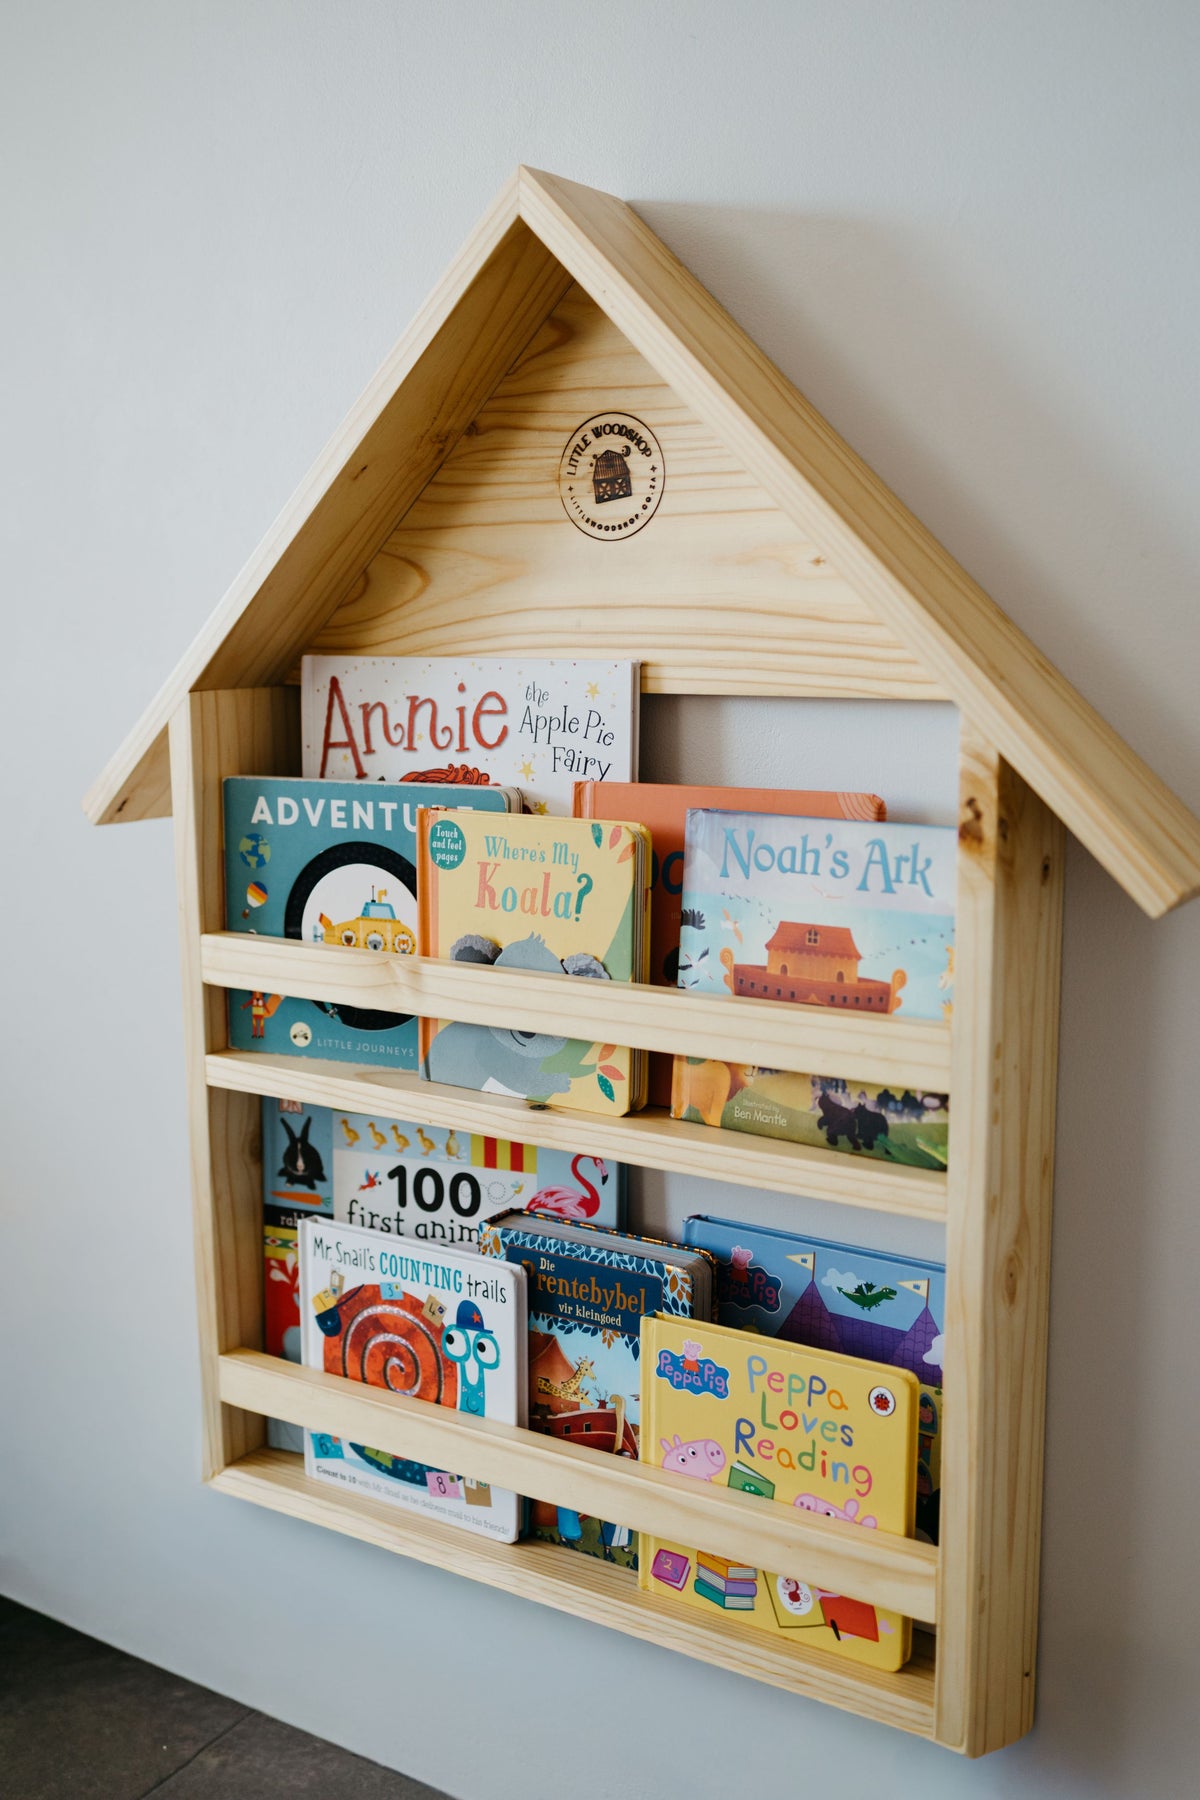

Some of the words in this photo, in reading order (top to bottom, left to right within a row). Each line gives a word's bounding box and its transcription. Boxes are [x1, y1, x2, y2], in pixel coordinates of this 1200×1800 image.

[567, 434, 592, 476] LITTLE
[591, 423, 652, 457] WOODSHOP
[525, 681, 550, 708] the
[319, 675, 509, 779] Annie
[518, 705, 580, 745] Apple
[583, 709, 615, 747] Pie
[551, 746, 612, 782] Fairy
[251, 796, 473, 833] ADVENTU
[435, 825, 459, 839] Touch
[432, 838, 446, 849] and
[447, 839, 462, 851] feel
[435, 852, 458, 865] pages
[484, 835, 547, 864] Where's
[552, 841, 580, 875] My
[719, 827, 850, 880] Noah's
[856, 838, 935, 898] Ark
[474, 861, 594, 922] Koala?
[317, 1038, 355, 1050] LITTLE
[355, 1042, 415, 1057] JOURNEYS
[734, 1106, 752, 1120] Ben
[753, 1109, 788, 1127] Mantle
[387, 1165, 482, 1218] 100
[347, 1199, 405, 1237] first
[415, 1219, 480, 1245] anim
[313, 1236, 334, 1260] Mr.
[335, 1242, 376, 1271] Snail's
[379, 1252, 463, 1294] COUNTING
[467, 1273, 507, 1304] trails
[539, 1257, 556, 1272] Die
[386, 1284, 394, 1298] 3
[753, 1272, 778, 1306] Pig
[428, 1303, 436, 1317] 4
[558, 1302, 573, 1315] vir
[576, 1304, 622, 1327] kleingoed
[660, 1352, 702, 1388] Peppa
[704, 1363, 726, 1392] Pig
[747, 1355, 848, 1411] Peppa
[760, 1391, 854, 1447] Loves
[319, 1436, 329, 1456] 6
[735, 1418, 873, 1497] Reading
[436, 1476, 447, 1495] 8
[663, 1558, 672, 1570] 2
[670, 1567, 679, 1580] 3
